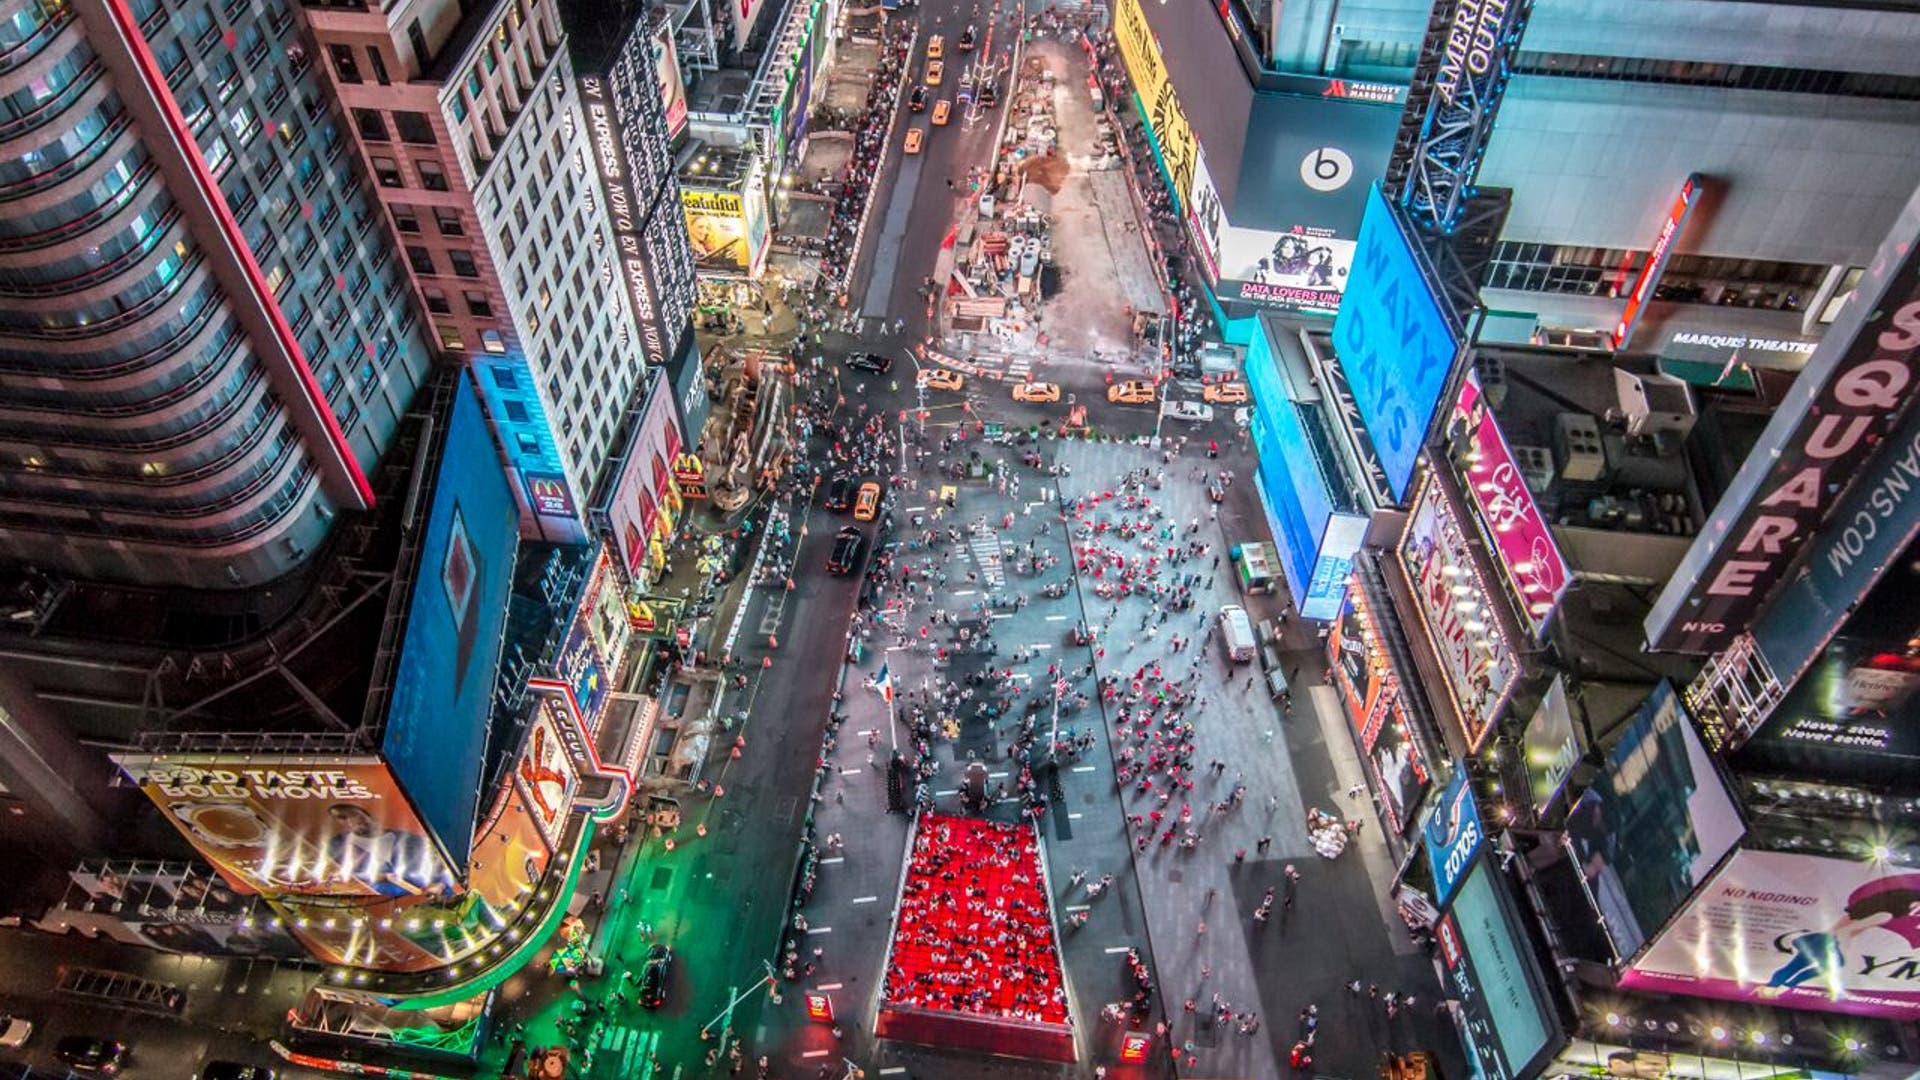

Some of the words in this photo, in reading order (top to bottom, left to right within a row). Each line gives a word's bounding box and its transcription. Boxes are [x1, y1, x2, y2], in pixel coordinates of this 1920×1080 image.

[590, 103, 620, 178] EXPRESS
[628, 260, 653, 321] EXPRESS
[1242, 283, 1270, 295] DATA
[1272, 286, 1318, 300] LOVERS
[1319, 291, 1344, 303] UNI
[1364, 223, 1438, 387] WAVY
[1672, 333, 1747, 348] MARQUIS
[1748, 338, 1819, 353] THEATRE
[1346, 303, 1408, 454] DAYS
[1707, 301, 1920, 596] SQUARE
[1681, 621, 1726, 634] NYC
[551, 699, 586, 761] PALACE
[1782, 728, 1832, 743] Never
[1848, 725, 1890, 739] stop.
[159, 783, 252, 799] BOLD
[254, 784, 383, 800] MOVES.
[1722, 887, 1746, 898] NO
[1747, 890, 1820, 906] KIDDING!
